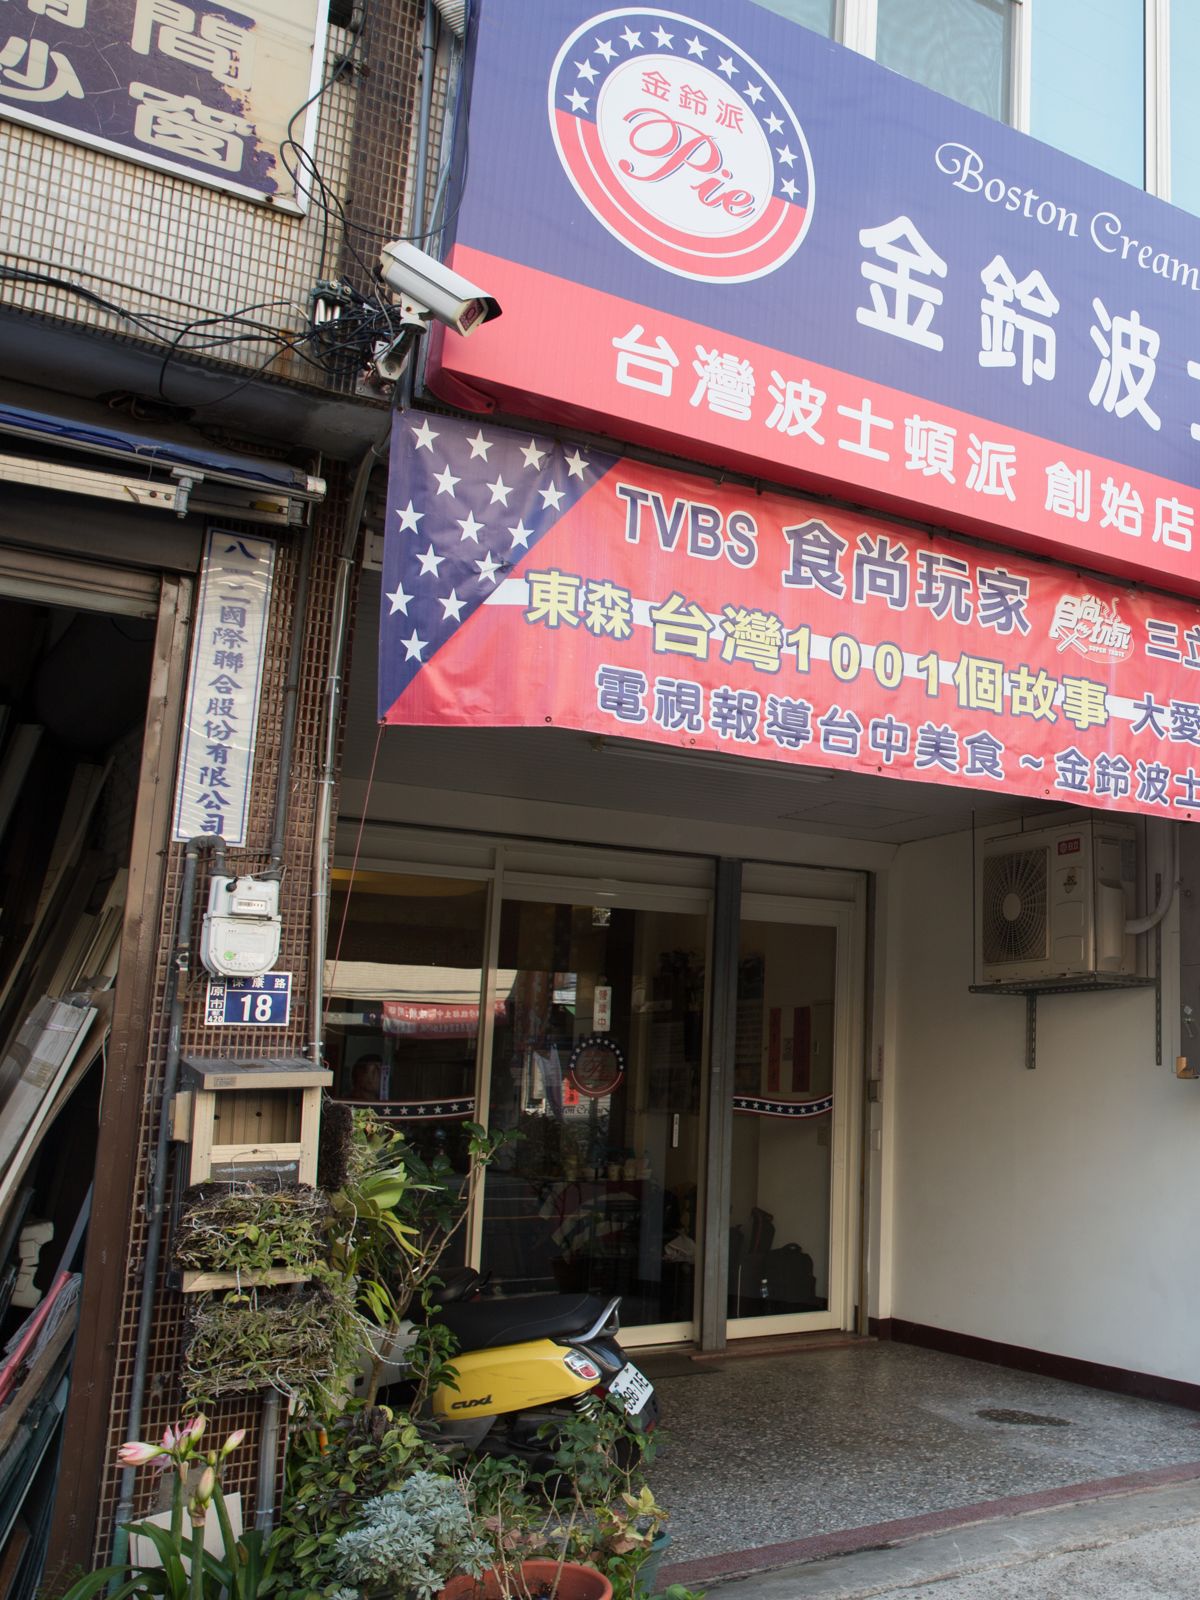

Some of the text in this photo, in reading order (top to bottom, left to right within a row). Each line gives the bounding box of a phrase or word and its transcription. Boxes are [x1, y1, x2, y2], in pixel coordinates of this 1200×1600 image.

[618, 107, 756, 219] Pie
[641, 70, 745, 134] 金鈴派
[935, 142, 1080, 239] Boston
[1090, 212, 1200, 292] Cream
[612, 324, 1196, 552] 台灣波士頓派 創始店
[616, 483, 1031, 636] TVBS 食尚玩家
[524, 567, 1110, 731] 東森 台灣1001個故事
[208, 1015, 224, 1023] 420
[240, 994, 273, 1022] 18
